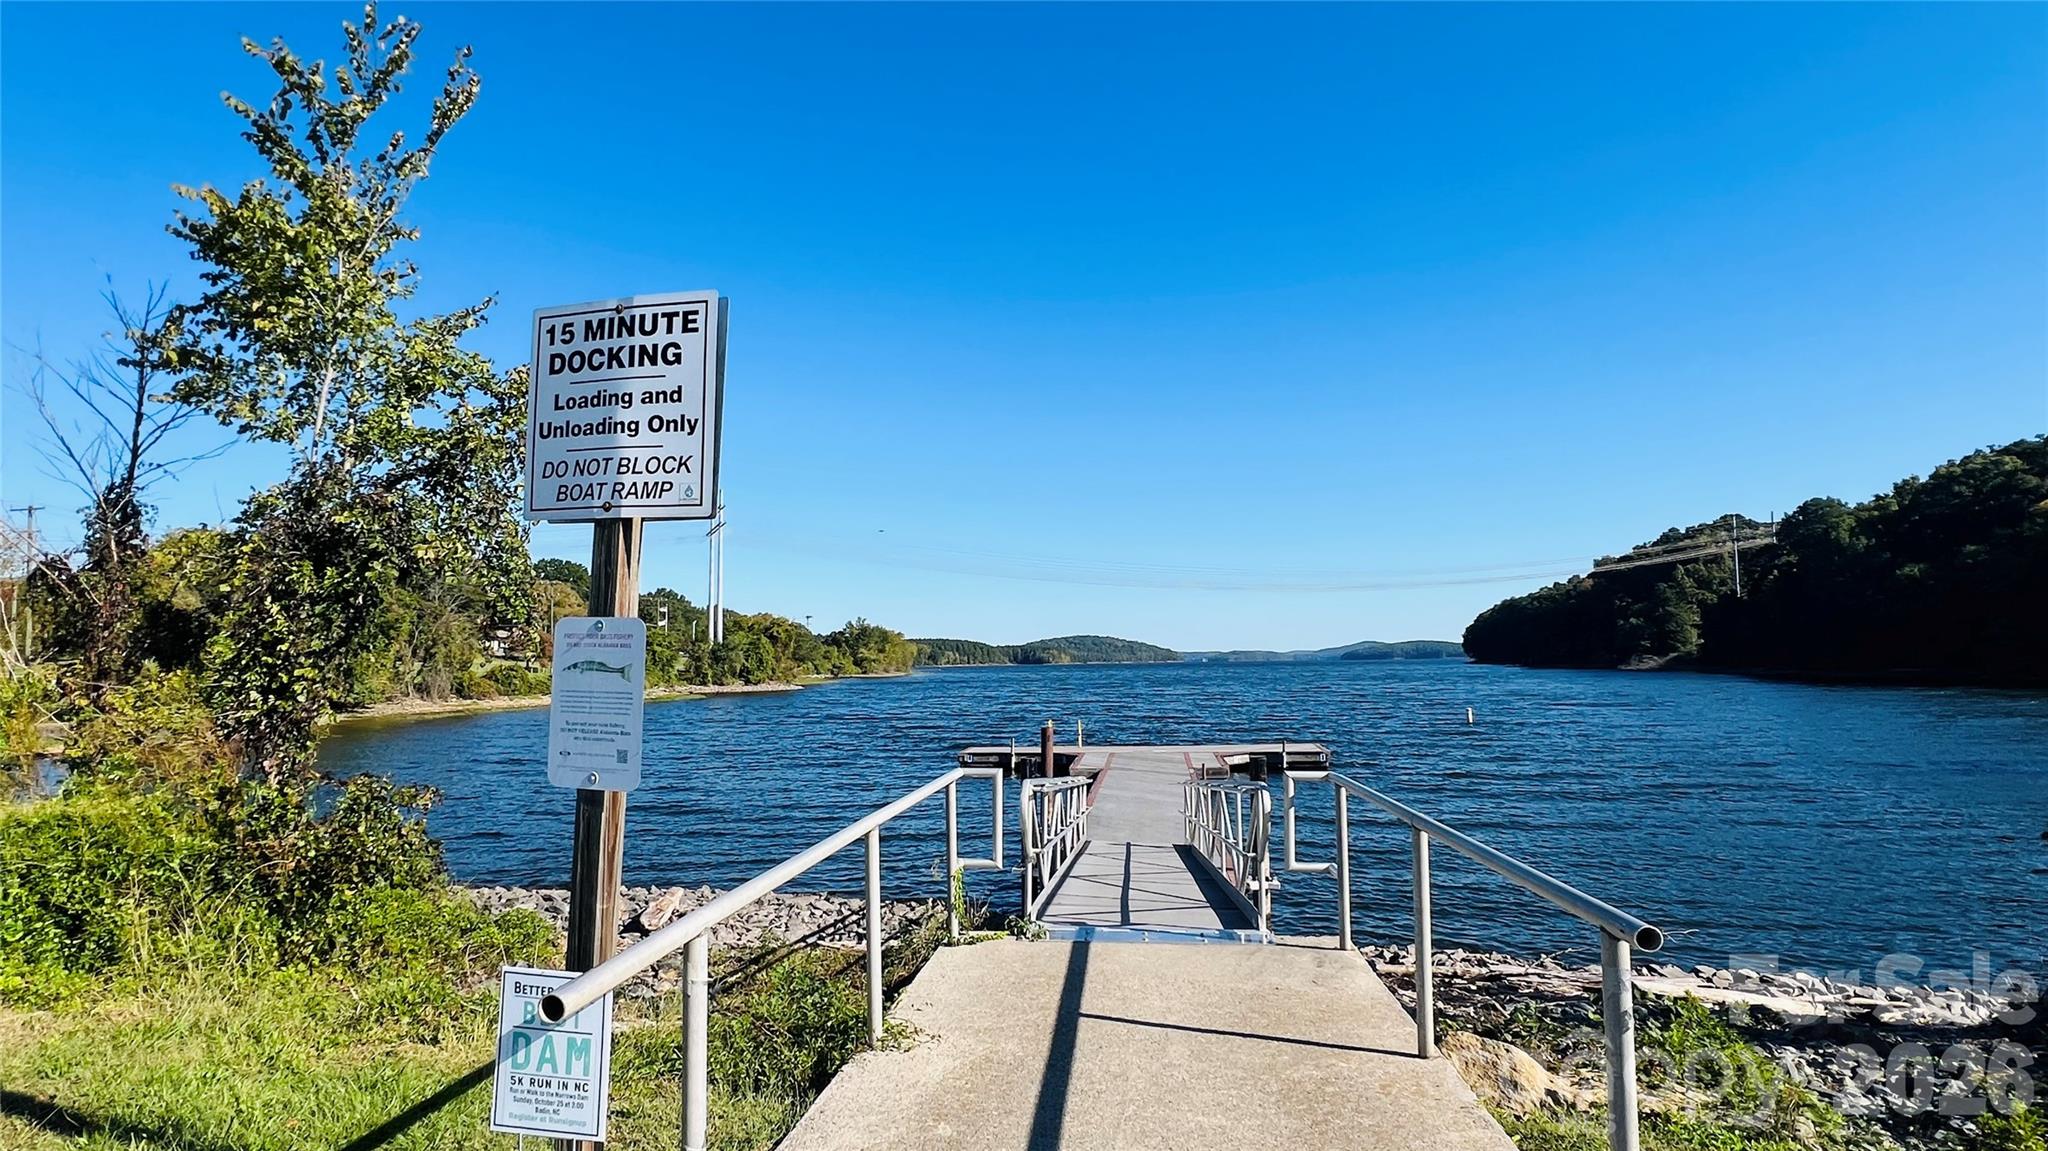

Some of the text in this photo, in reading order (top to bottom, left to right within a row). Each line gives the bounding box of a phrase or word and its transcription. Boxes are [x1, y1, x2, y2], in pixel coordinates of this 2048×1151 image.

[546, 310, 700, 346] 15 MINUTE
[549, 342, 682, 376] DOCKING
[554, 385, 682, 411] Loading and
[539, 414, 699, 439] Unloading Only
[542, 455, 693, 479] DO NOT BLOCK
[556, 481, 673, 502] BOAT RAMP
[511, 1031, 591, 1077] DAM
[510, 1075, 590, 1093] 5K RUN IN NC
[535, 1098, 555, 1106] October
